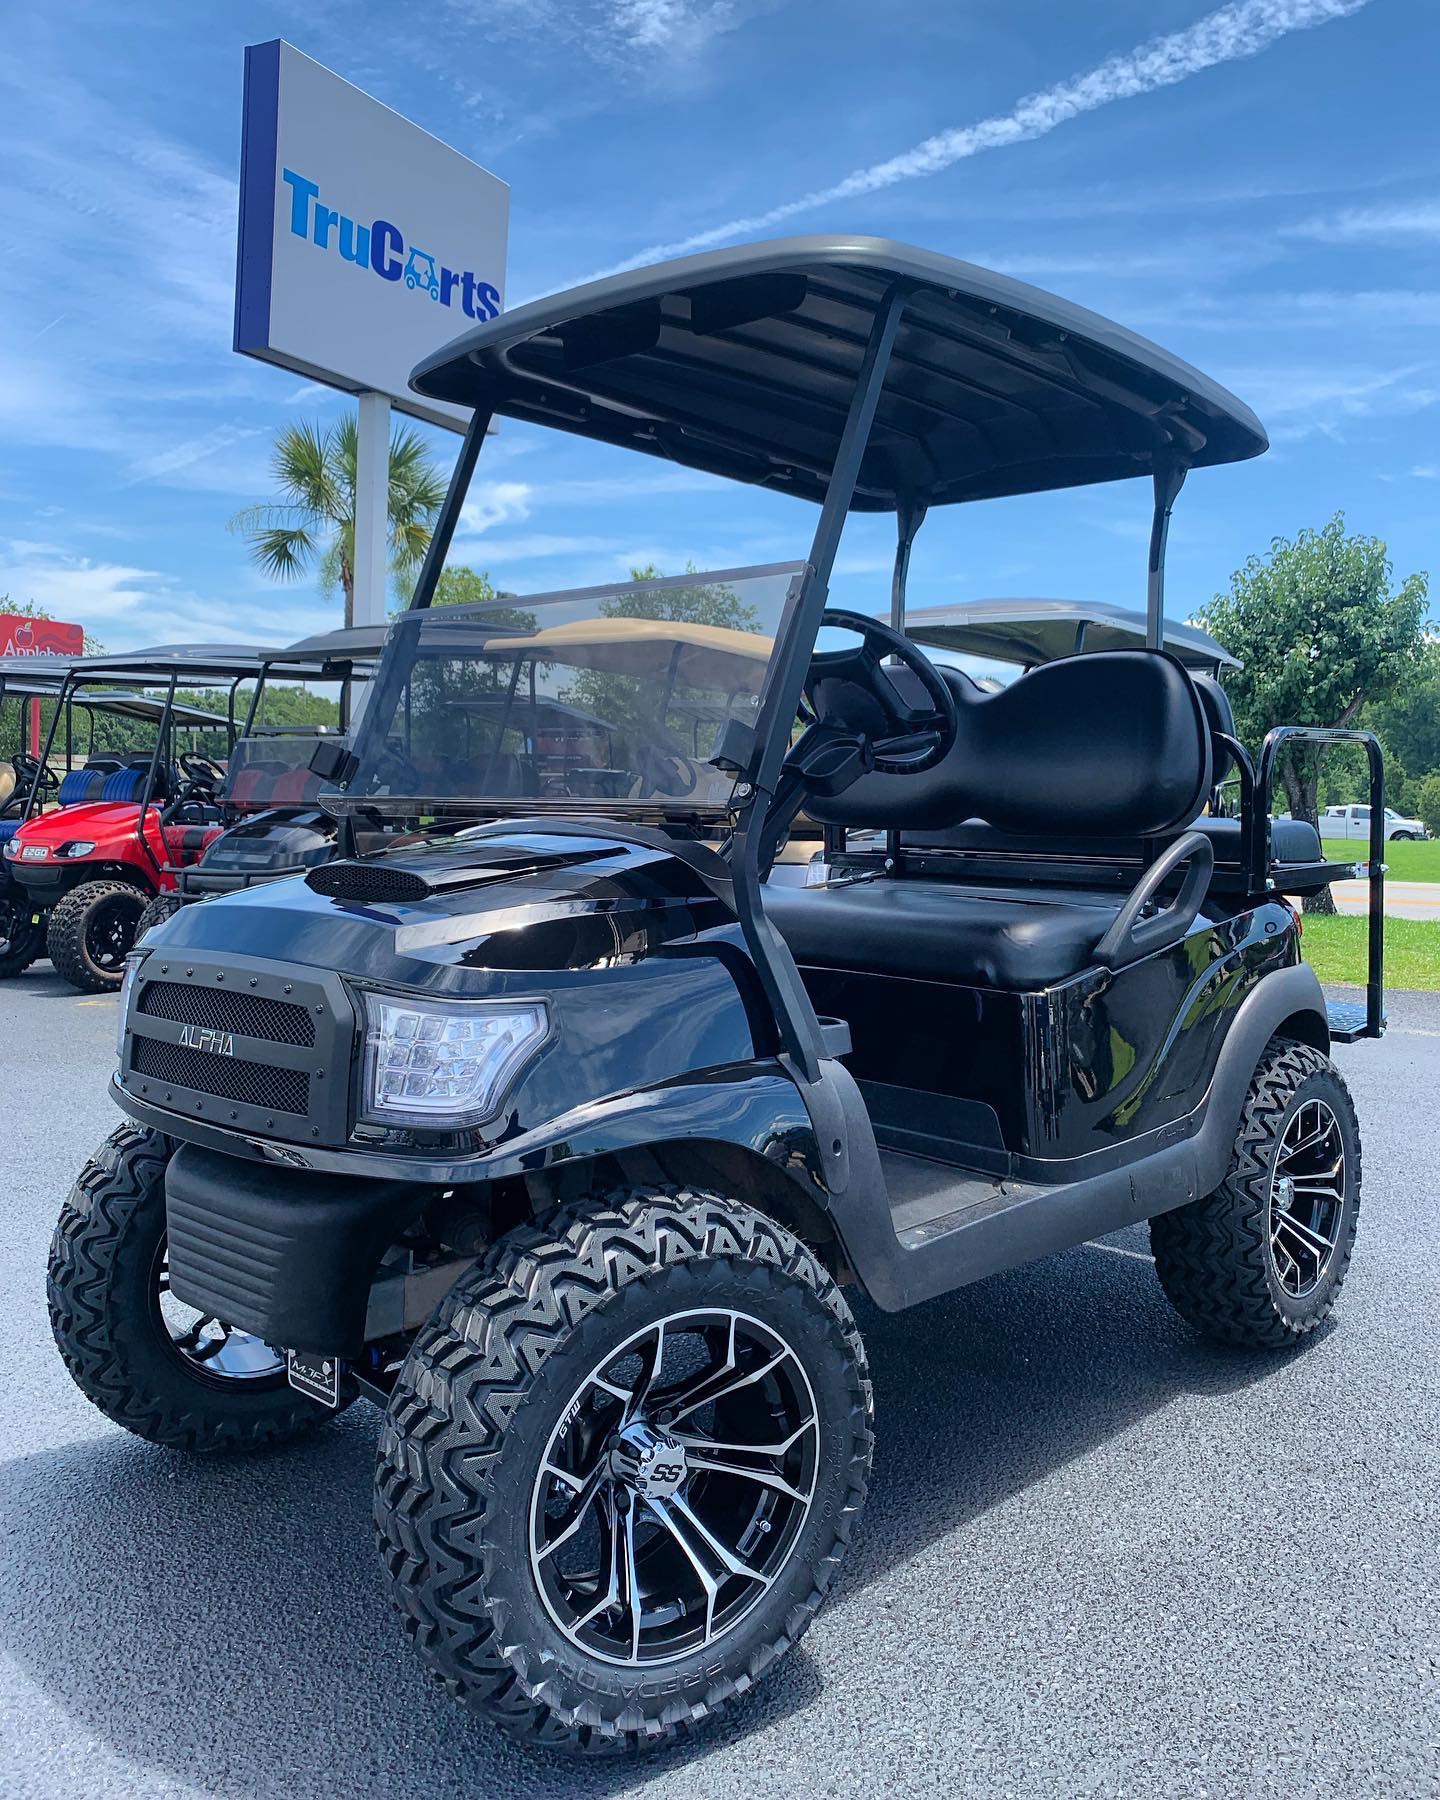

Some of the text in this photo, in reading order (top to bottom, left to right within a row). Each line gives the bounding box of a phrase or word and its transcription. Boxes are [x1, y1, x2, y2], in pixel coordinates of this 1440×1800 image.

[3, 639, 78, 657] Appleb'
[178, 1026, 233, 1056] ALPHA
[559, 1399, 581, 1439] GTW
[649, 1464, 683, 1483] SS
